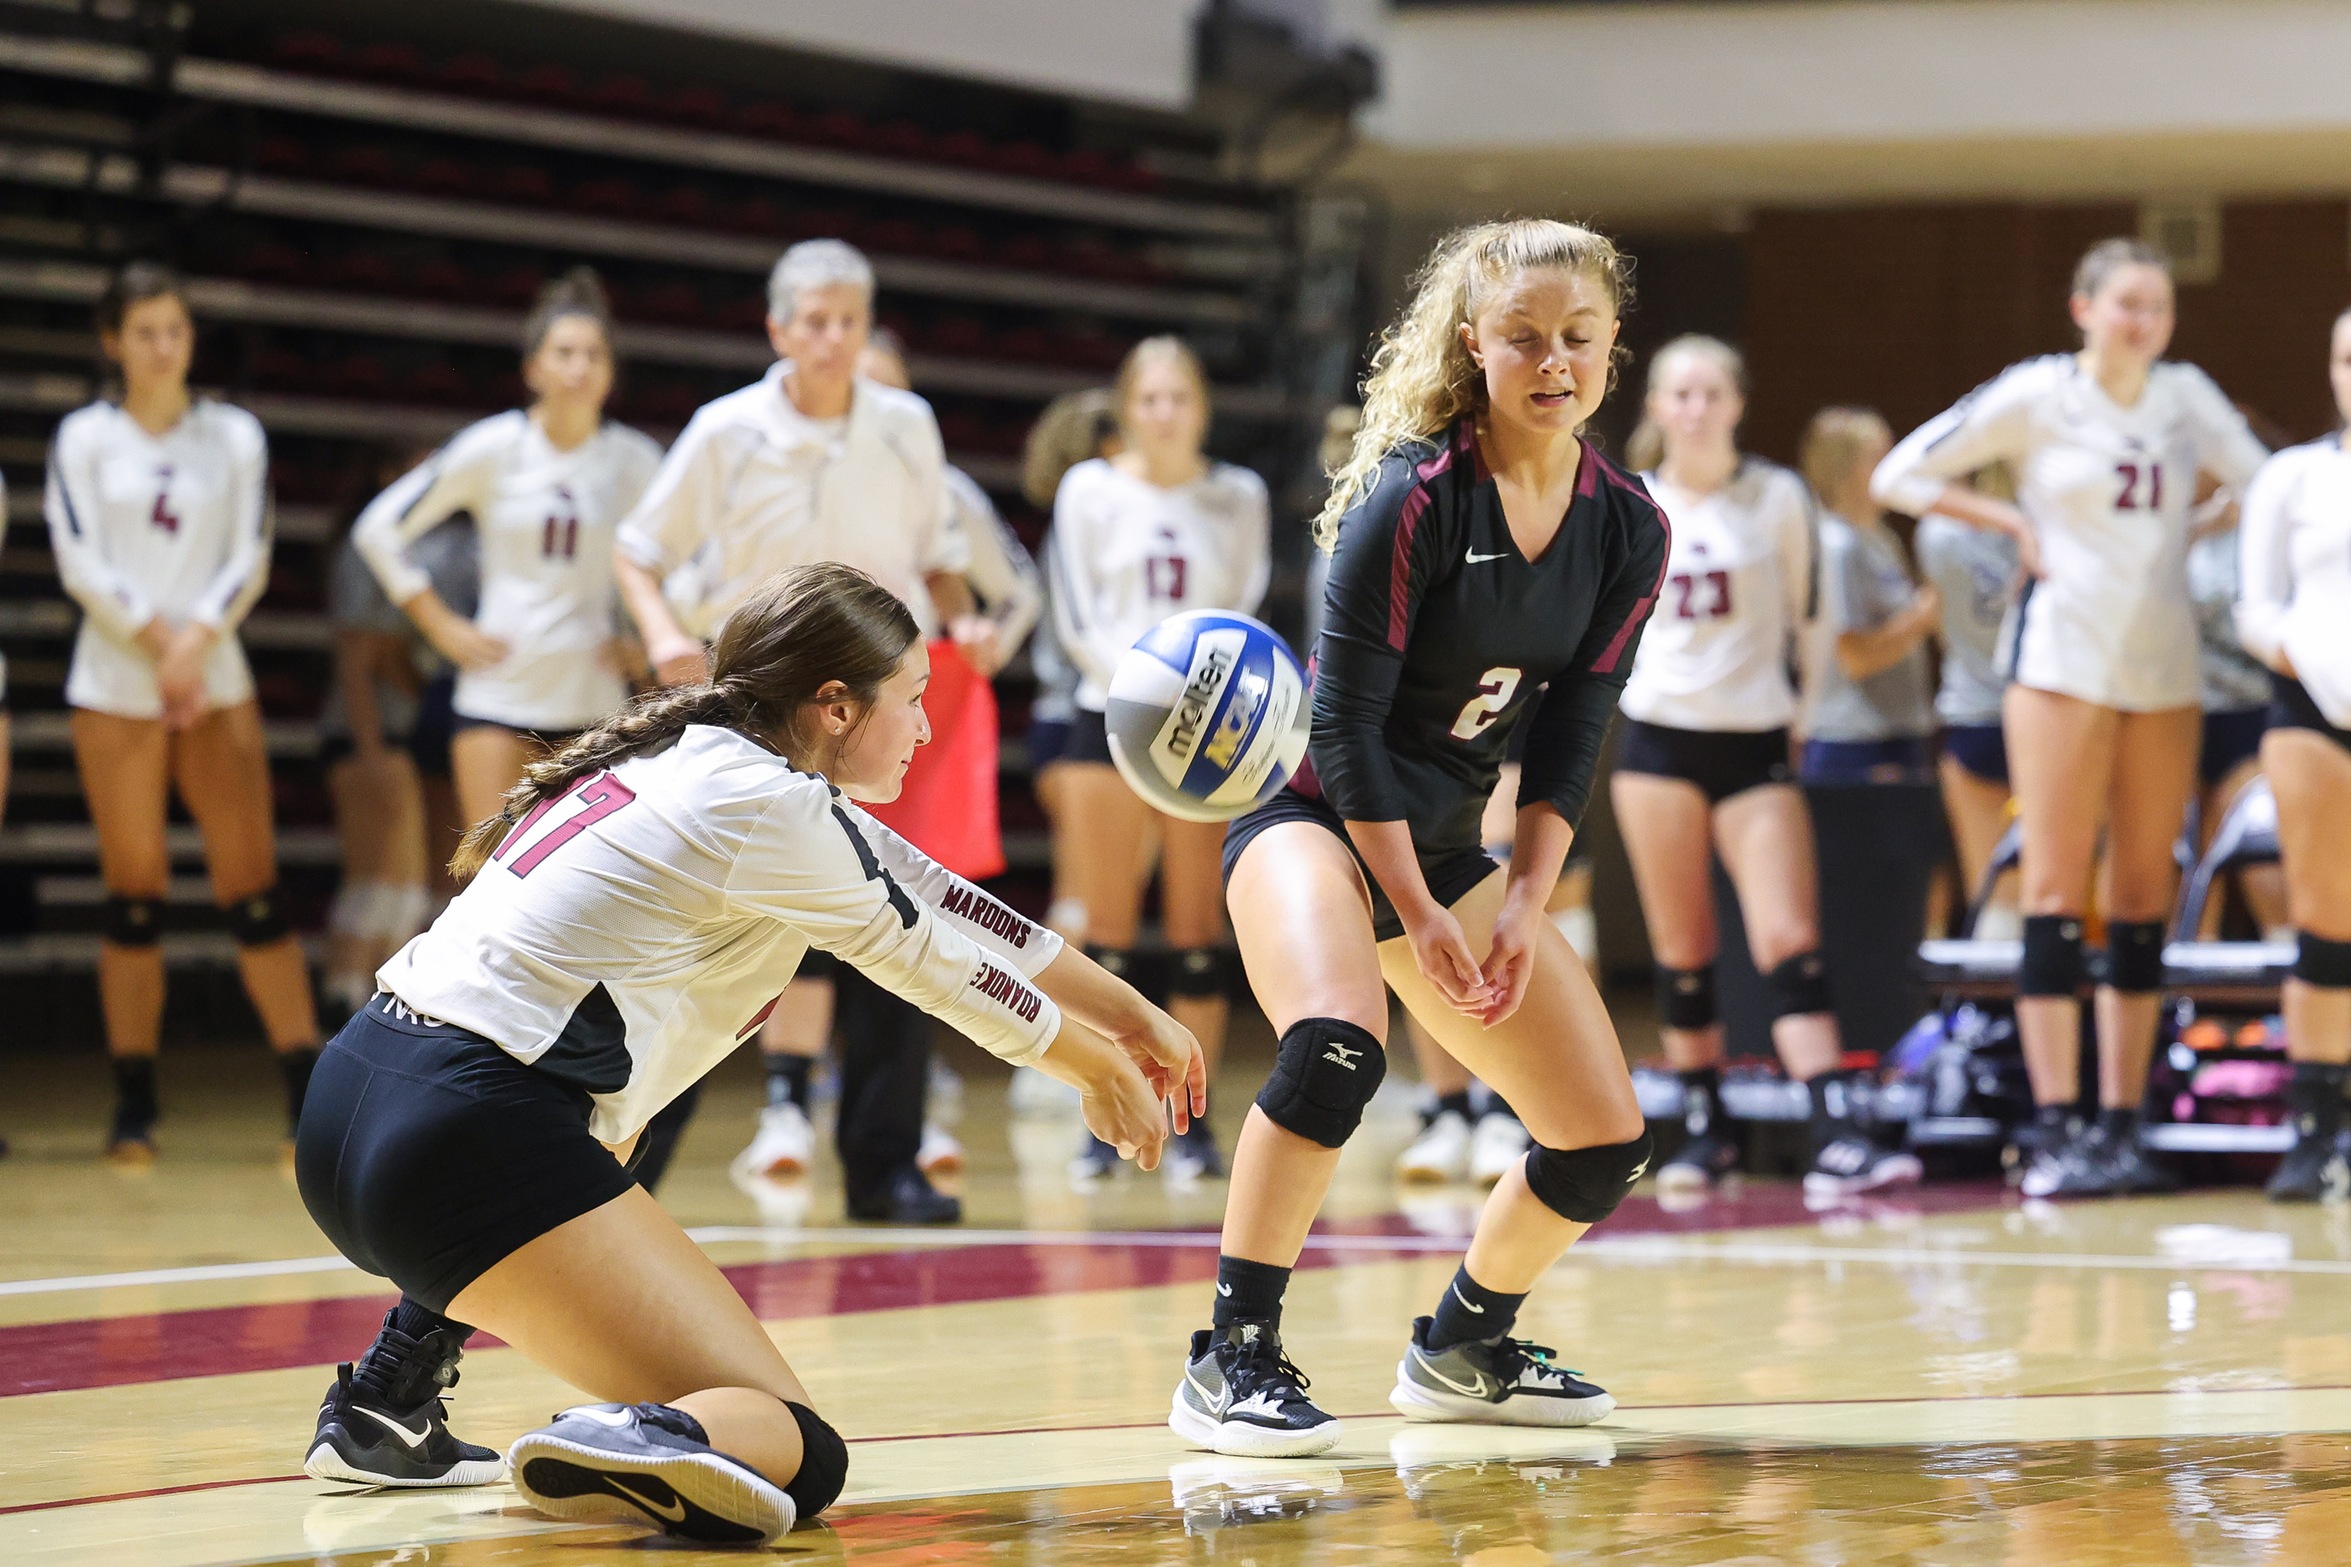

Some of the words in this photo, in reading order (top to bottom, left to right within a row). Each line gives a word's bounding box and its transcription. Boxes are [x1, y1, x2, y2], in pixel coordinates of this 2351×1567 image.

[151, 491, 180, 537] 4
[2115, 462, 2162, 511] 21
[542, 514, 580, 559] 11
[1671, 569, 1731, 618] 23
[1167, 645, 1232, 760] molten
[1448, 665, 1523, 741] 2
[492, 768, 637, 880] 17
[939, 884, 1032, 949] MAROONS
[969, 962, 1042, 1023] ROANOKE
